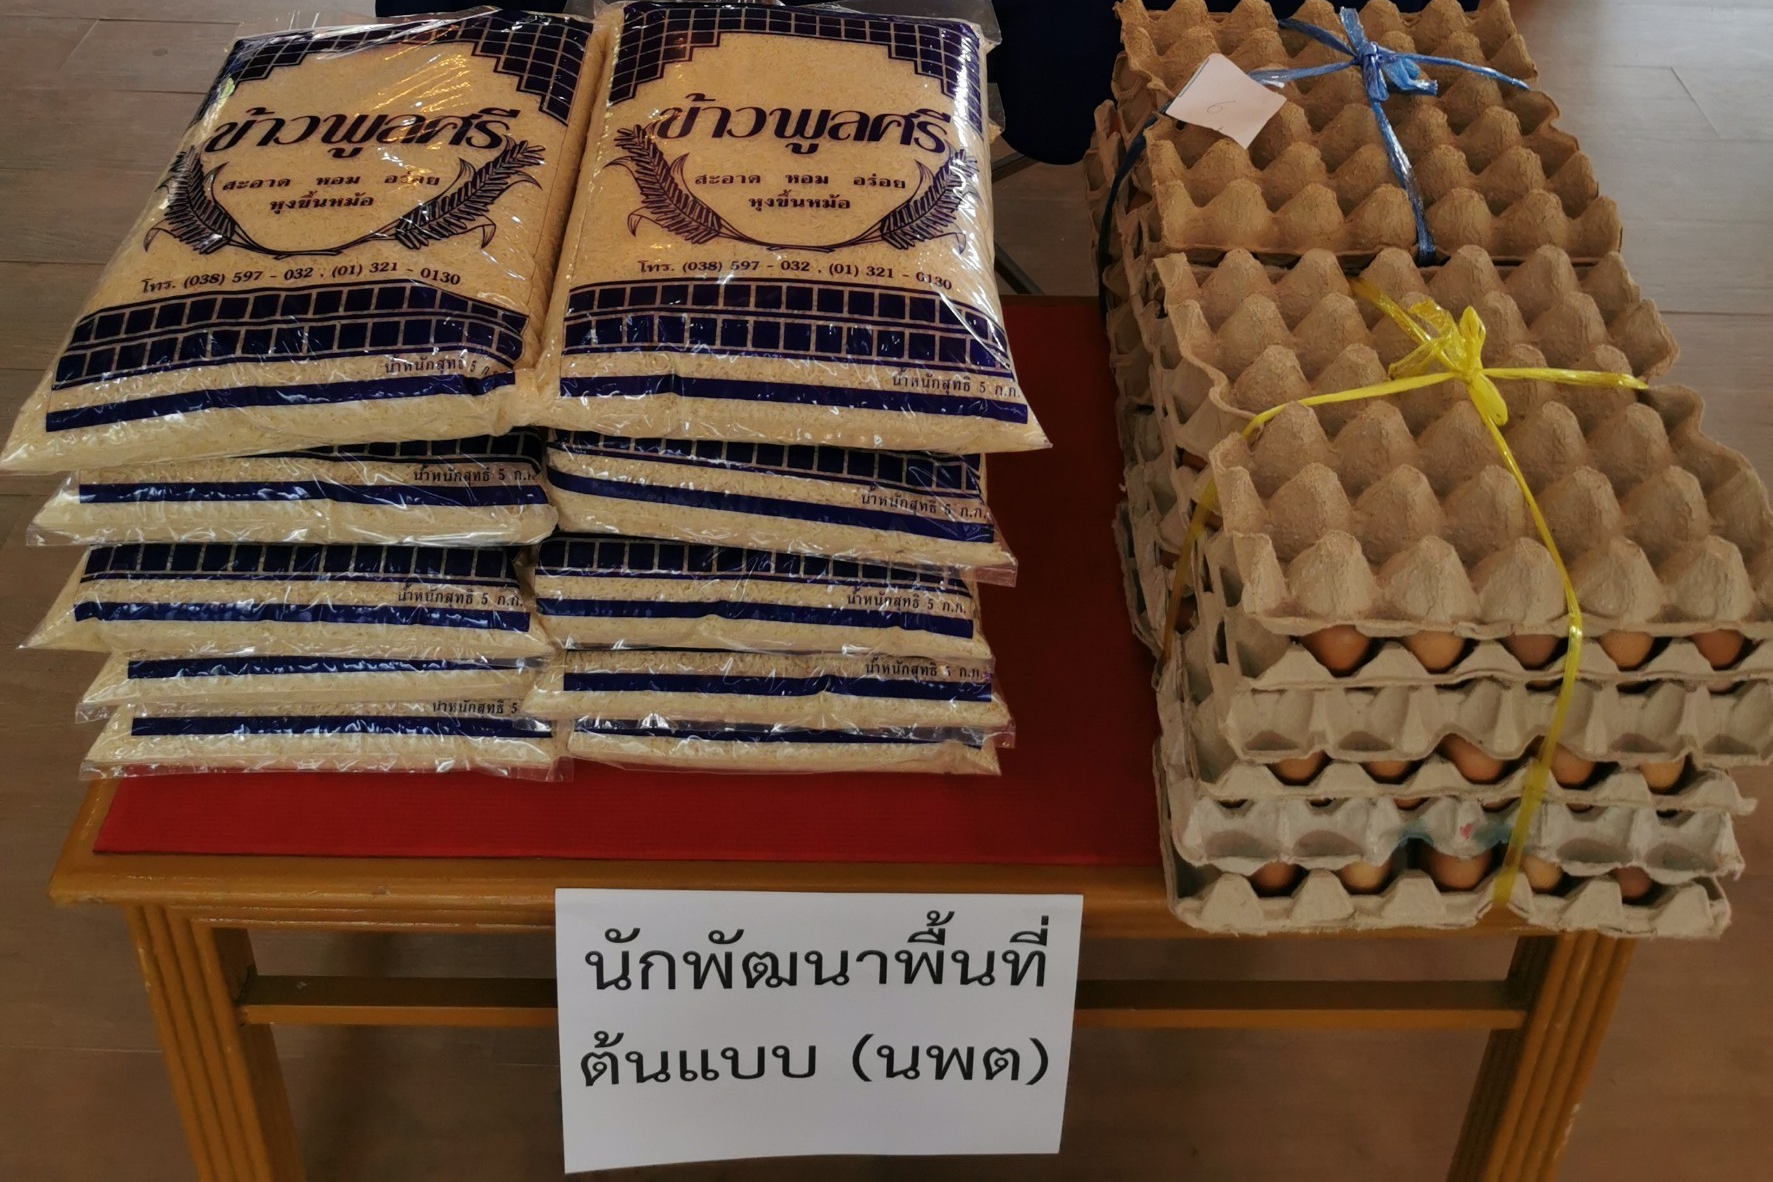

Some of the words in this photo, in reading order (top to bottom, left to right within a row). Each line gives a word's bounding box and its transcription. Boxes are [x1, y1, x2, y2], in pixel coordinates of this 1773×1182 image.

[204, 107, 521, 158] ข้าวพูลศรี
[656, 92, 951, 154] ข้าวพูลศรี
[222, 177, 291, 191] สะอาด
[316, 175, 361, 186] หอม
[384, 171, 440, 186] อร่อย
[695, 174, 761, 185] สะอาด
[785, 174, 829, 184] หอม
[853, 173, 906, 189] อร่อย
[269, 190, 374, 214] หุงขึ้นหม้อ
[748, 189, 850, 211] หุงขึ้นหม้อ
[141, 279, 176, 293] โทร.
[184, 273, 225, 289] (038)
[232, 271, 263, 283] 597
[284, 268, 313, 280] 032
[332, 264, 363, 278] (01)
[369, 262, 397, 273] 321
[420, 268, 461, 285] 0130
[637, 260, 675, 273] โทร.
[682, 261, 723, 272] (038)
[731, 261, 760, 271] 597
[781, 261, 810, 272] 032
[829, 263, 859, 277] (01)
[866, 265, 894, 278] 321
[979, 381, 986, 393] 5
[498, 468, 505, 480] 5
[481, 593, 489, 605] 5
[927, 598, 934, 610] 5
[511, 702, 518, 714] 5
[584, 910, 1050, 991] นักพัฒนาพื้นที่
[580, 1030, 818, 1087] ต้นแบบ
[851, 1033, 1050, 1086] (นพต)
